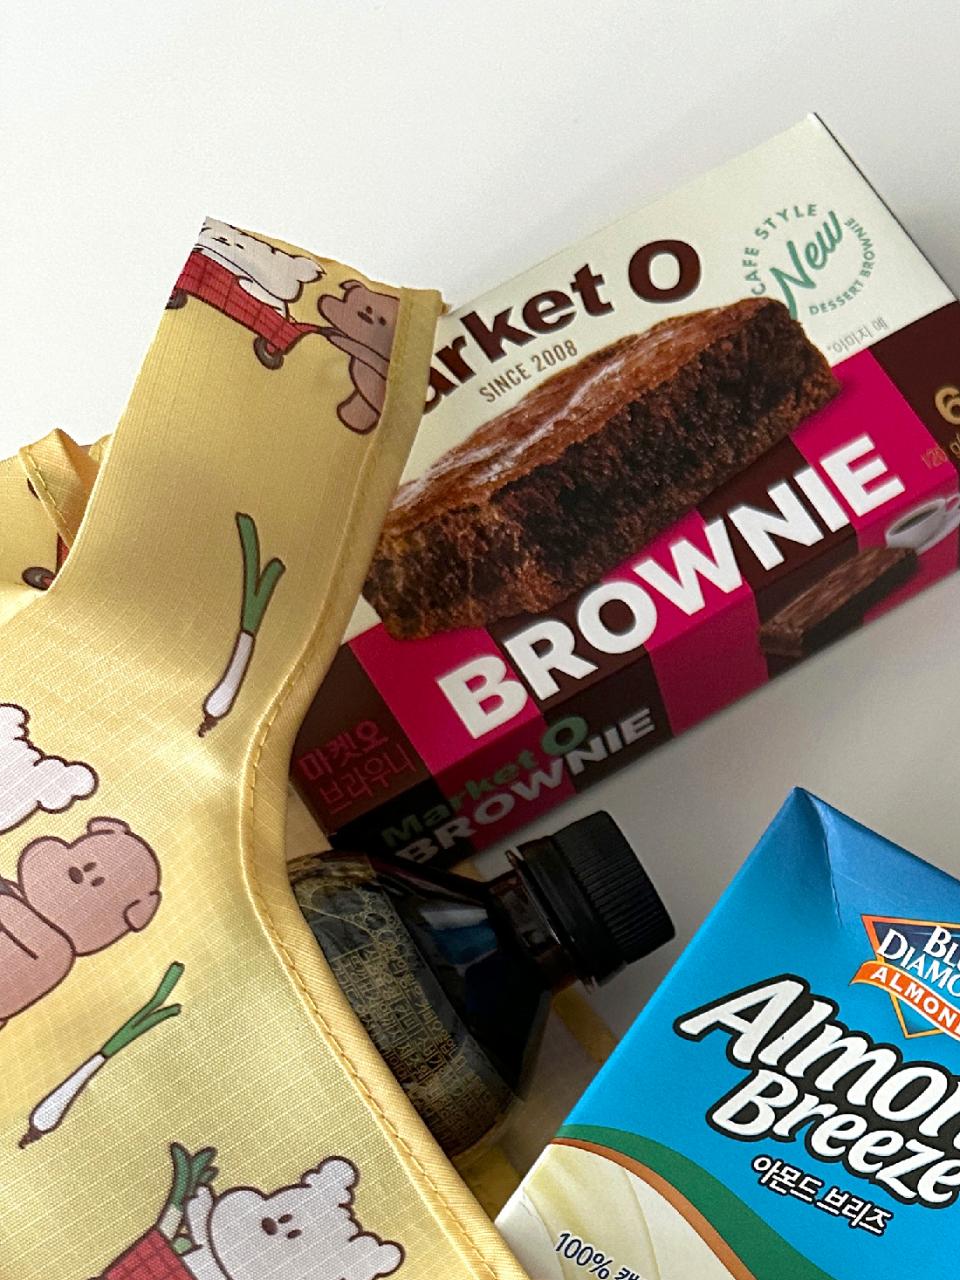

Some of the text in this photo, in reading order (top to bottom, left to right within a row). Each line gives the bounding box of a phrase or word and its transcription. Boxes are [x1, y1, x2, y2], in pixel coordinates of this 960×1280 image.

[743, 203, 818, 295] CAFE STYLE
[769, 210, 843, 320] New
[808, 217, 876, 316] DESSERT BROWNIE
[423, 239, 702, 415] arket O
[478, 339, 579, 403] SINCE 2008
[435, 433, 906, 741] BROWNIE
[299, 718, 390, 783] 마켓오
[320, 741, 418, 816] 브라우니
[381, 714, 589, 848] Market O
[394, 707, 657, 866] BROWNIE
[751, 1154, 895, 1237] 아몬드 브리즈
[554, 1232, 613, 1280] 100%
